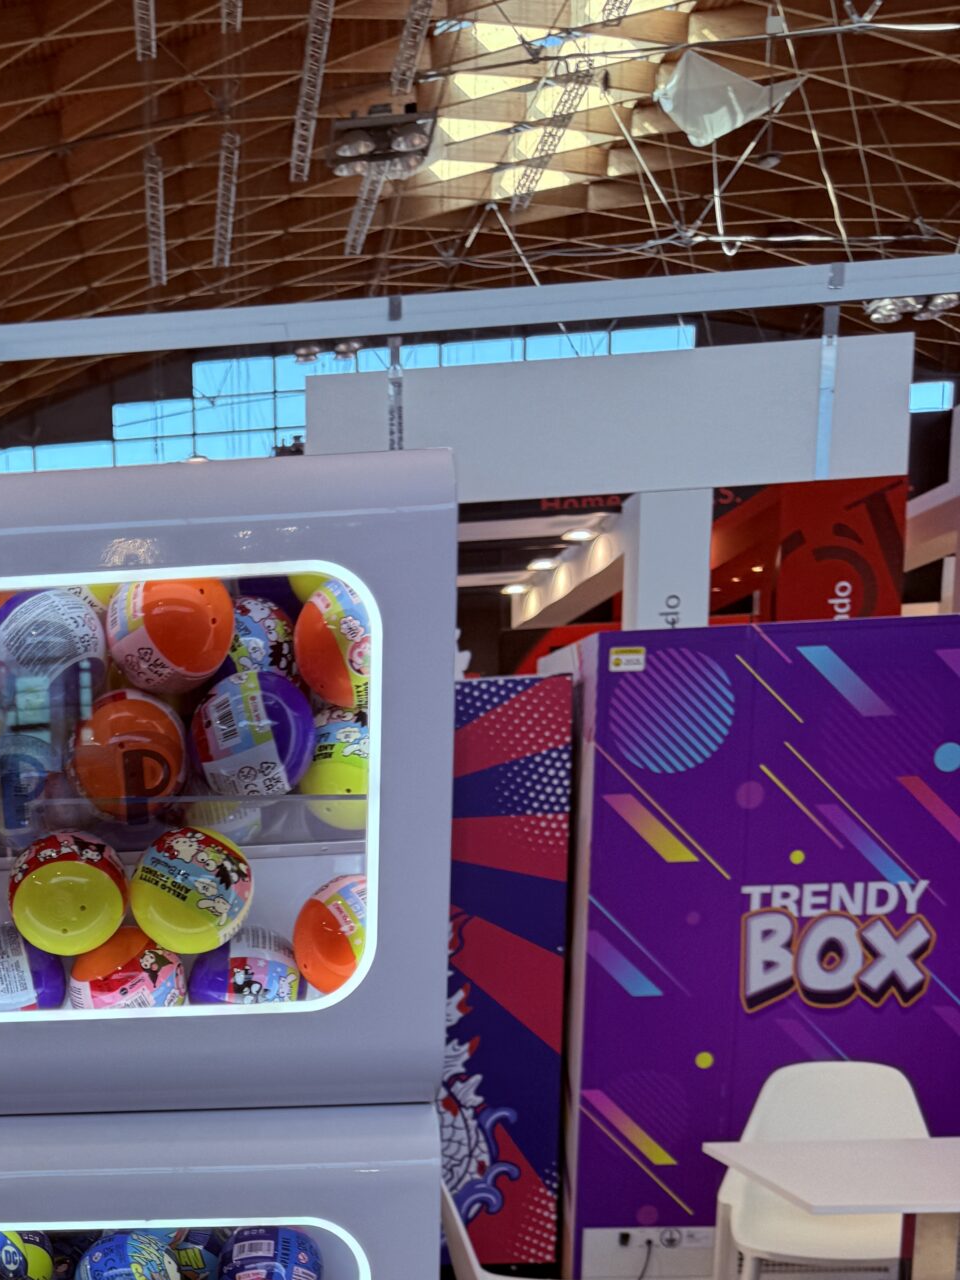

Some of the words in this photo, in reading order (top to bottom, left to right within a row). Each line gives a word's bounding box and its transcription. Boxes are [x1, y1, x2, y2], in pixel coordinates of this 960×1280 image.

[741, 880, 929, 917] TRENDY
[741, 909, 935, 1010] BOX
[4, 1249, 18, 1265] DC
